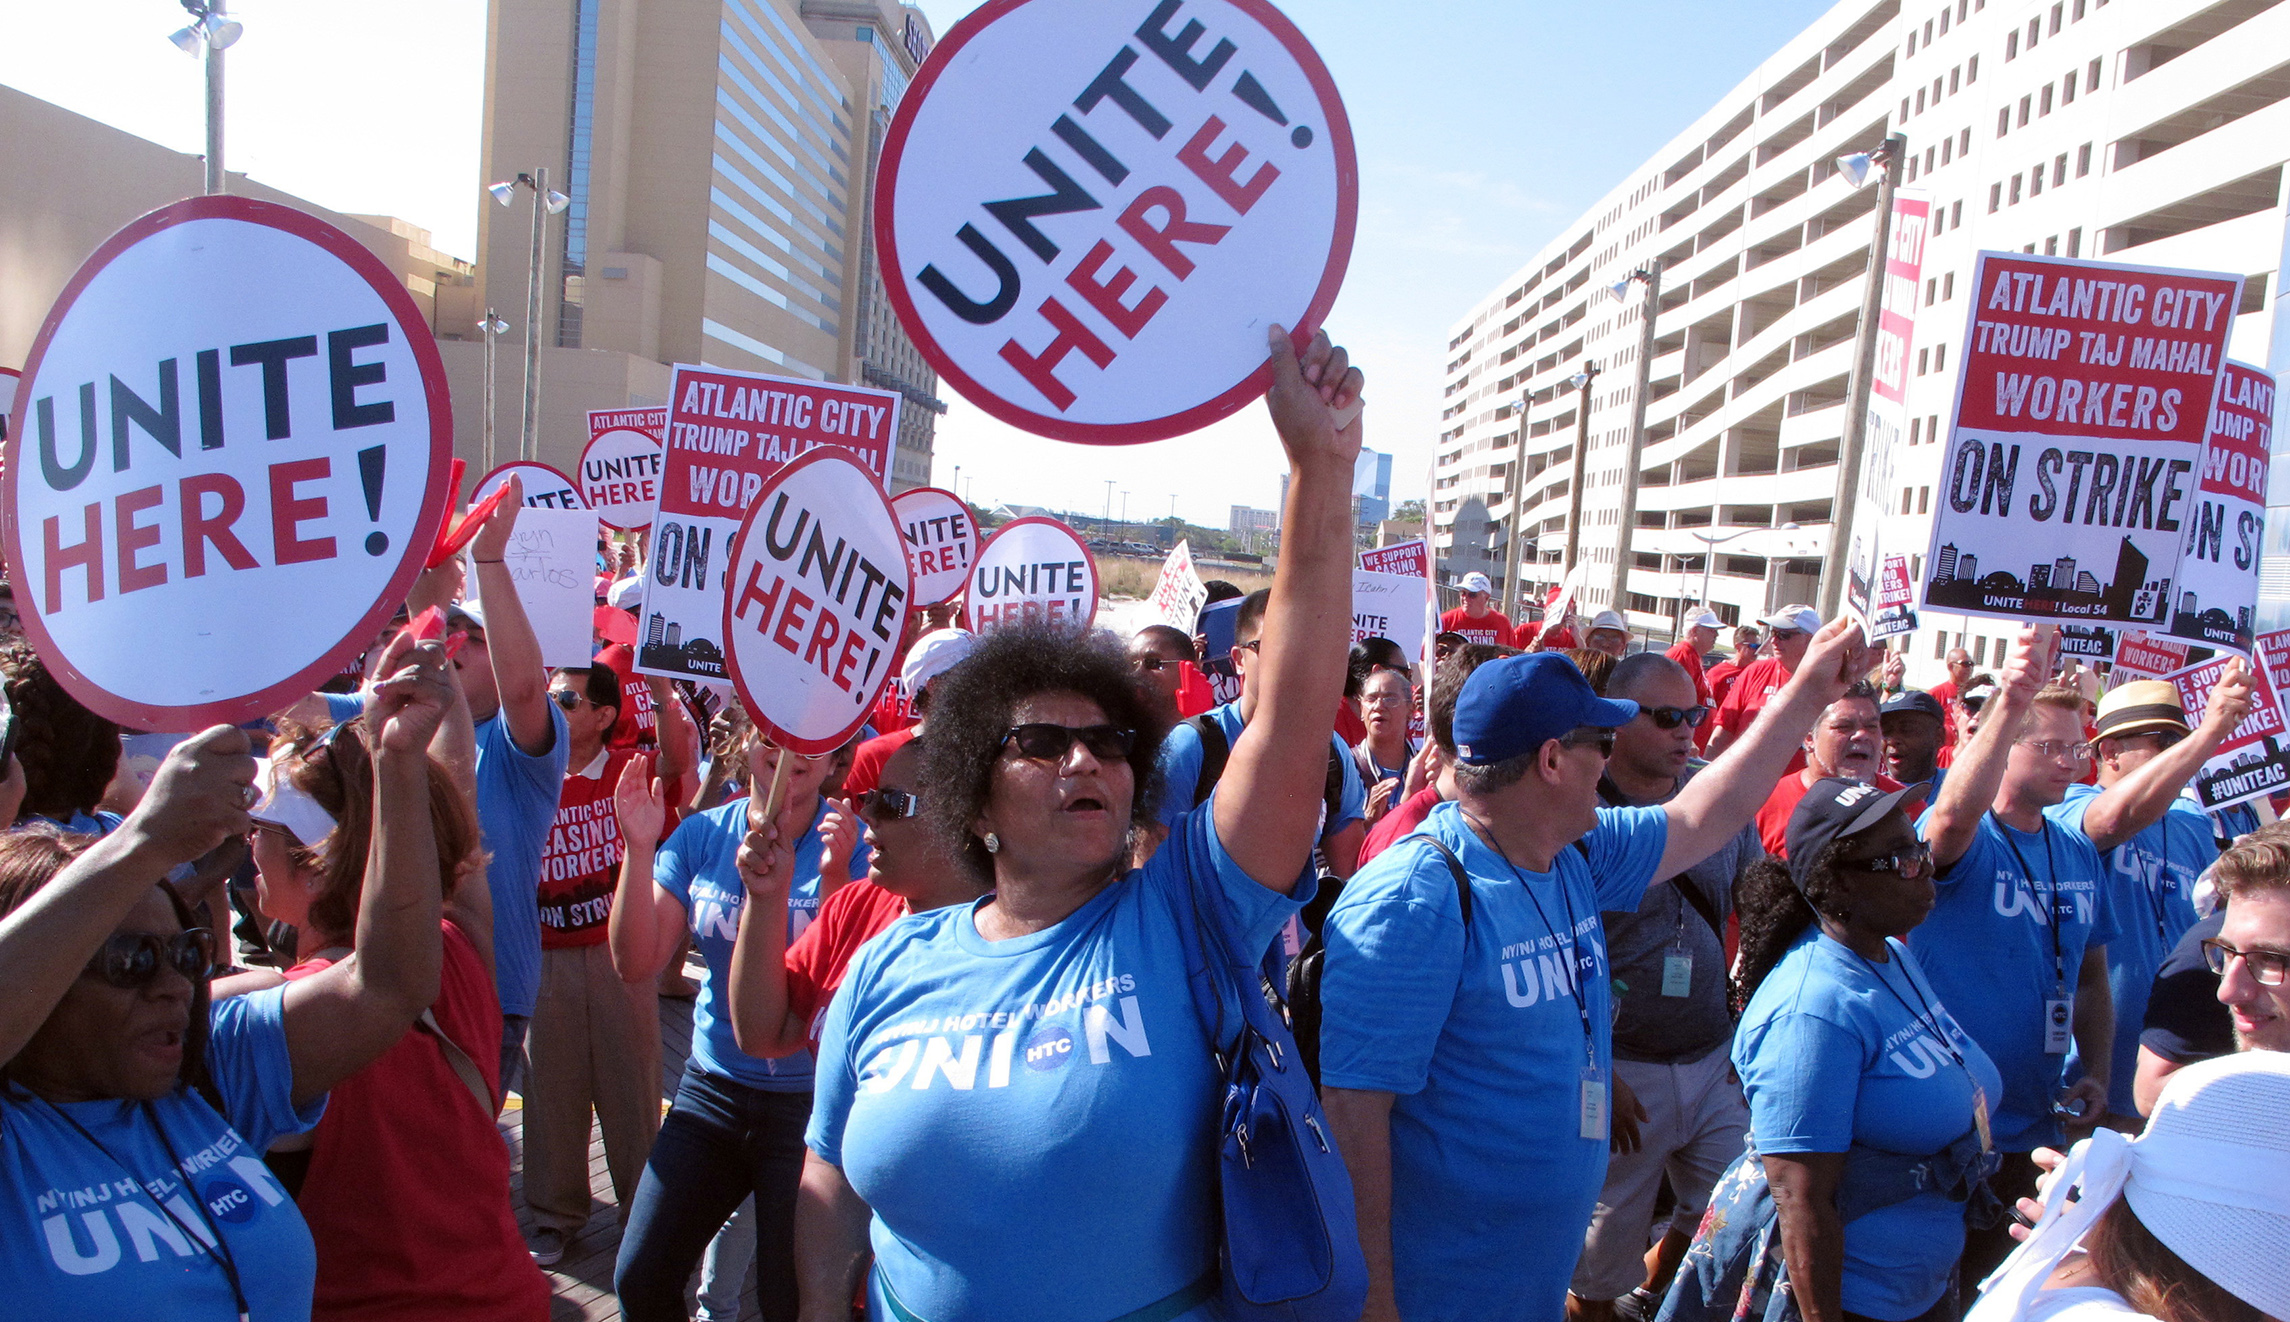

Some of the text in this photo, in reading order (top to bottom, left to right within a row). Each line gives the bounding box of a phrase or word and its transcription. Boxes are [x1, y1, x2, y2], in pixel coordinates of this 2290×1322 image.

[916, 0, 1238, 325] UNITE
[998, 69, 1313, 413] HERE!
[1988, 271, 2226, 332] ATLANTIC CITY
[1976, 321, 2213, 376] TRUMP TAJ MAHAL
[37, 322, 396, 492] UNITE
[681, 380, 886, 439] ATLANTIC CITY
[1995, 372, 2182, 432] WORKERS
[594, 412, 667, 429] ATLANTIC CIT
[673, 422, 749, 457] TRUMP
[756, 433, 797, 463] TAJ
[586, 453, 662, 482] UNITE
[1949, 438, 2191, 532] ON STRIKE
[42, 444, 390, 616] HERE!
[902, 513, 967, 548] NITE
[655, 522, 712, 591] ON
[765, 491, 905, 643] UNITE
[1364, 545, 1422, 566] WE SUPPORT
[1375, 558, 1416, 575] CASINO
[511, 557, 579, 589] arlos
[978, 562, 1086, 599] UNITE
[1352, 613, 1388, 630] NITE
[2061, 602, 2090, 614] Local
[2093, 604, 2108, 615] 54
[735, 559, 880, 705] HERE!
[1467, 636, 1495, 646] ASINO
[2061, 636, 2103, 654] NITEAC
[2204, 627, 2236, 643] UNITE
[687, 658, 722, 673] UNITE
[2123, 646, 2176, 673] WORKERS
[2211, 763, 2287, 800] #UNITEAC
[593, 796, 616, 817] CIT
[2161, 880, 2176, 890] TC
[540, 905, 566, 928] ON
[1501, 939, 1536, 961] NY/NJ
[943, 1011, 1020, 1034] HOTEL
[1023, 973, 1137, 1021] WORKERS
[1026, 1036, 1072, 1063] HTC
[37, 1183, 112, 1214] NY/NJ
[209, 1188, 249, 1218] HTC
